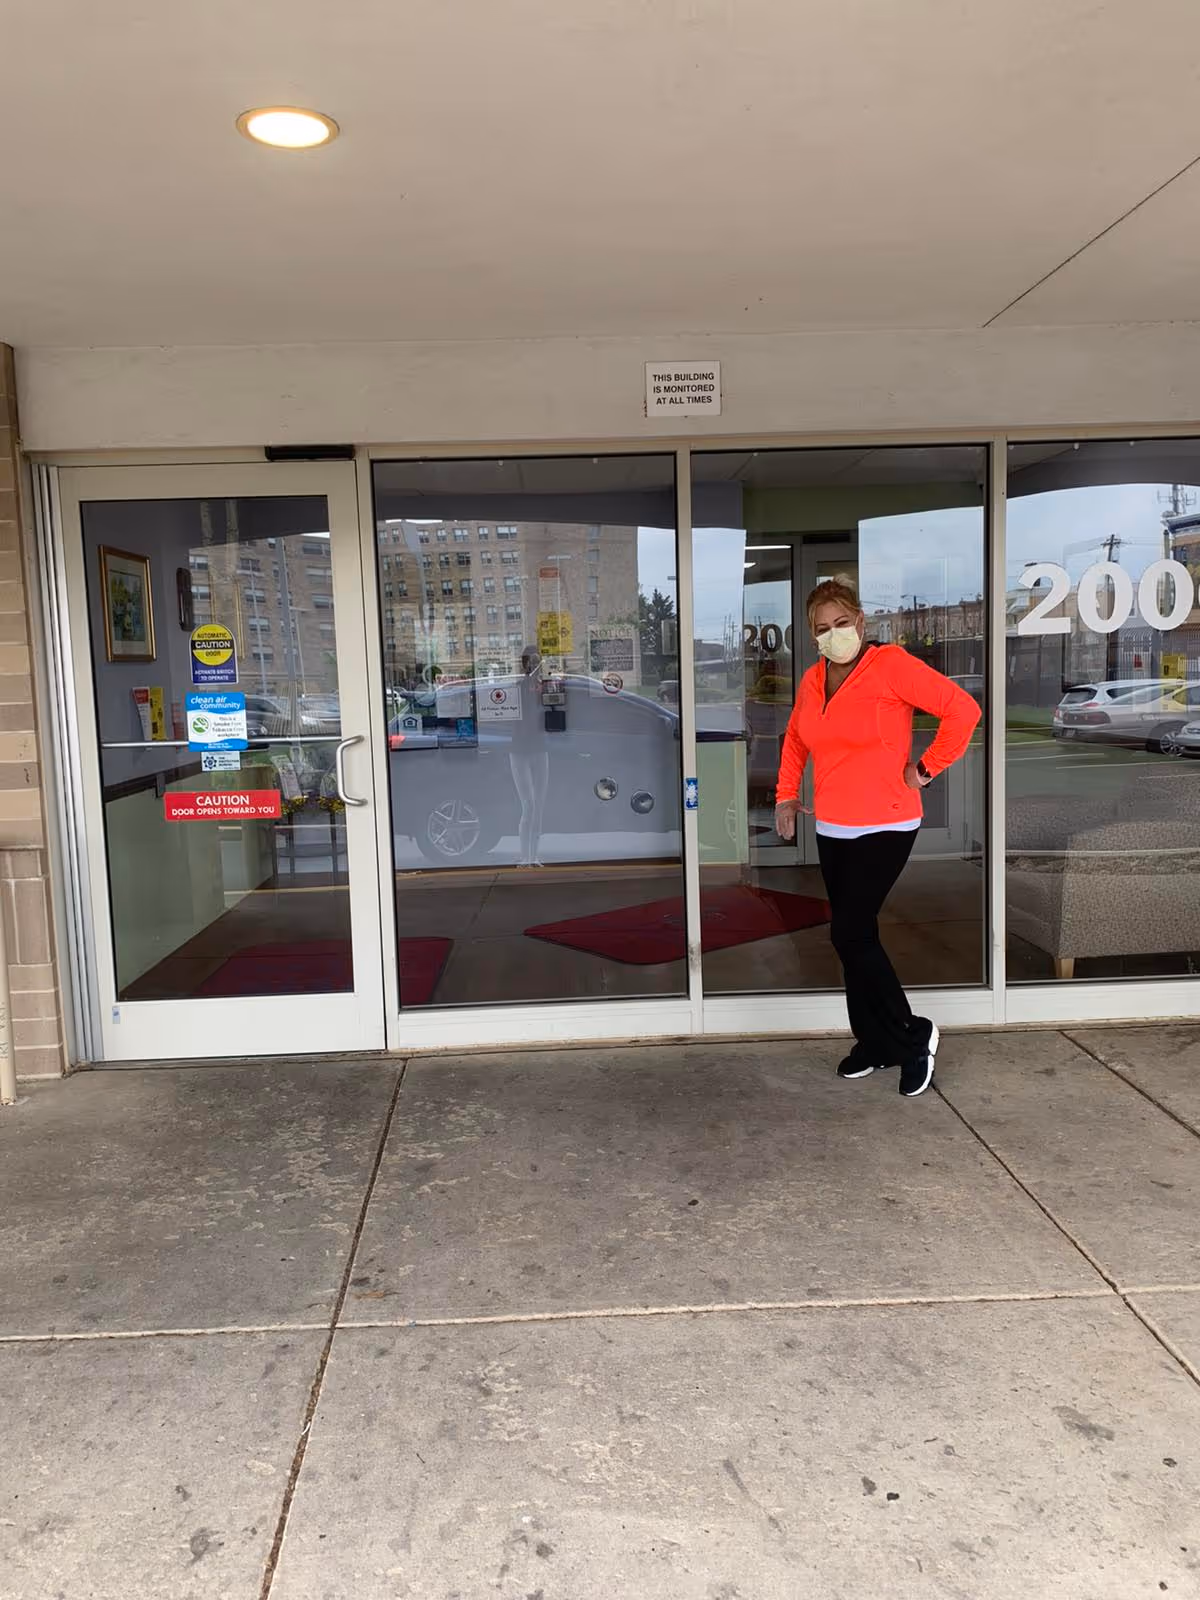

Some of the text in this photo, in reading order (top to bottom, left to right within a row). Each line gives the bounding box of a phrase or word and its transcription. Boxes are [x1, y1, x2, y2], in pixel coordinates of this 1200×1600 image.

[652, 372, 715, 382] THIS BUILDING
[653, 384, 715, 394] IS MONITORED
[656, 395, 713, 405] AT ALL TIMES
[1017, 558, 1200, 636] 200
[195, 640, 231, 649] CAUTION
[190, 695, 227, 704] clean air
[195, 795, 250, 806] CAUTION
[171, 806, 275, 816] DOOR OPENS TOWARD YOU
